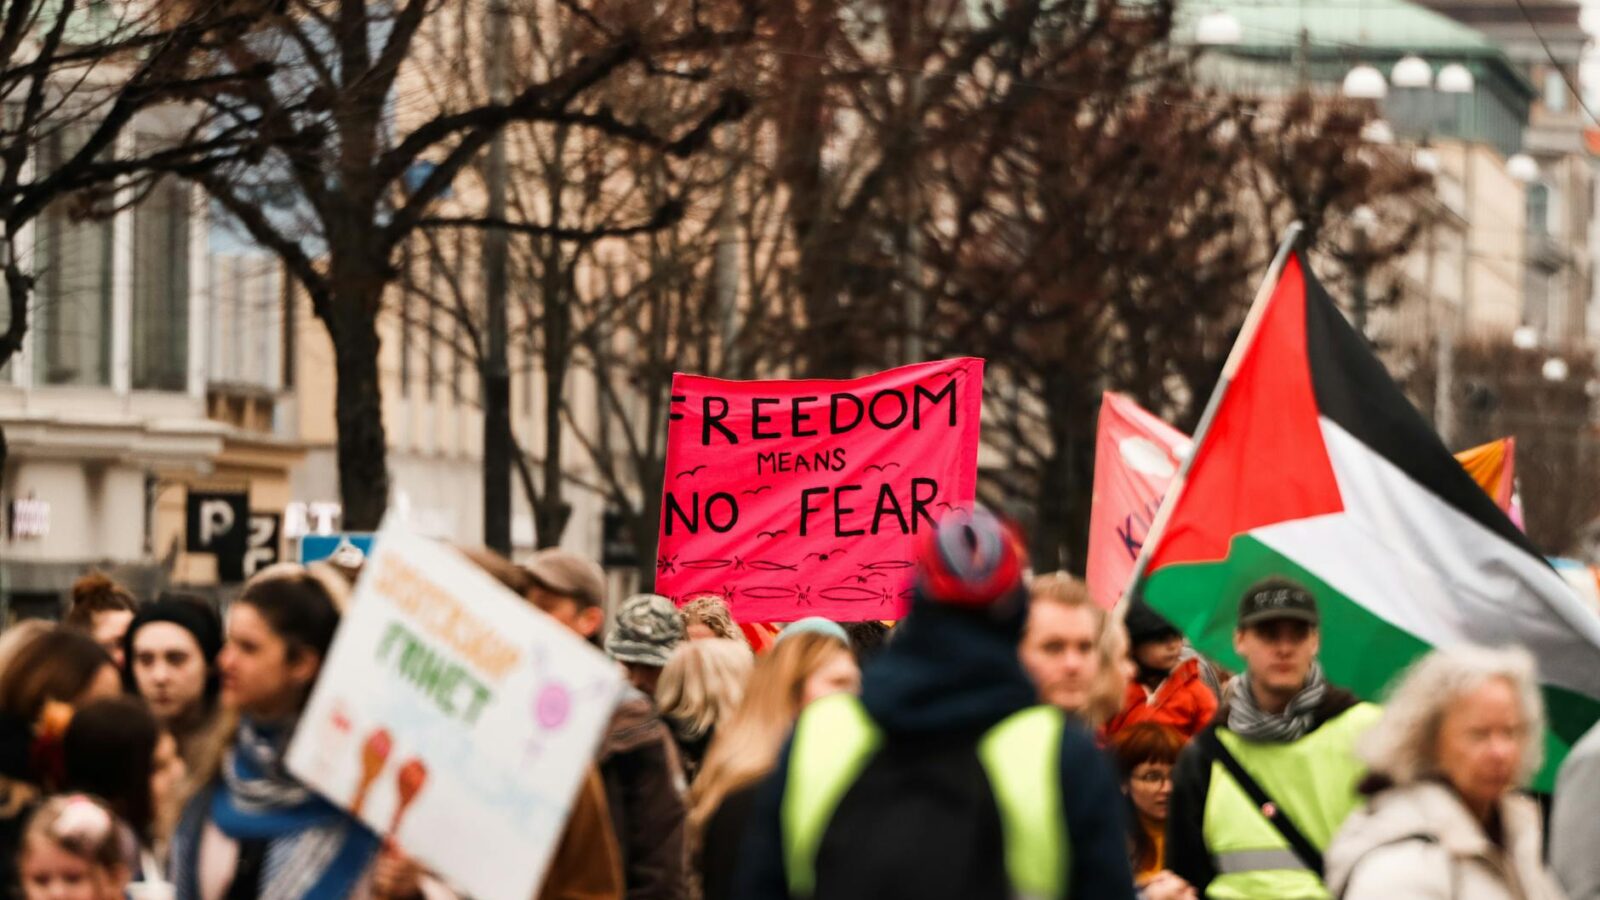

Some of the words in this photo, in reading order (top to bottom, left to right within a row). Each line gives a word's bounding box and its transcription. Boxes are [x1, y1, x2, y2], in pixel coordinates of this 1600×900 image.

[757, 447, 847, 476] MEANS
[664, 491, 739, 537] NO
[799, 477, 939, 537] FEAR
